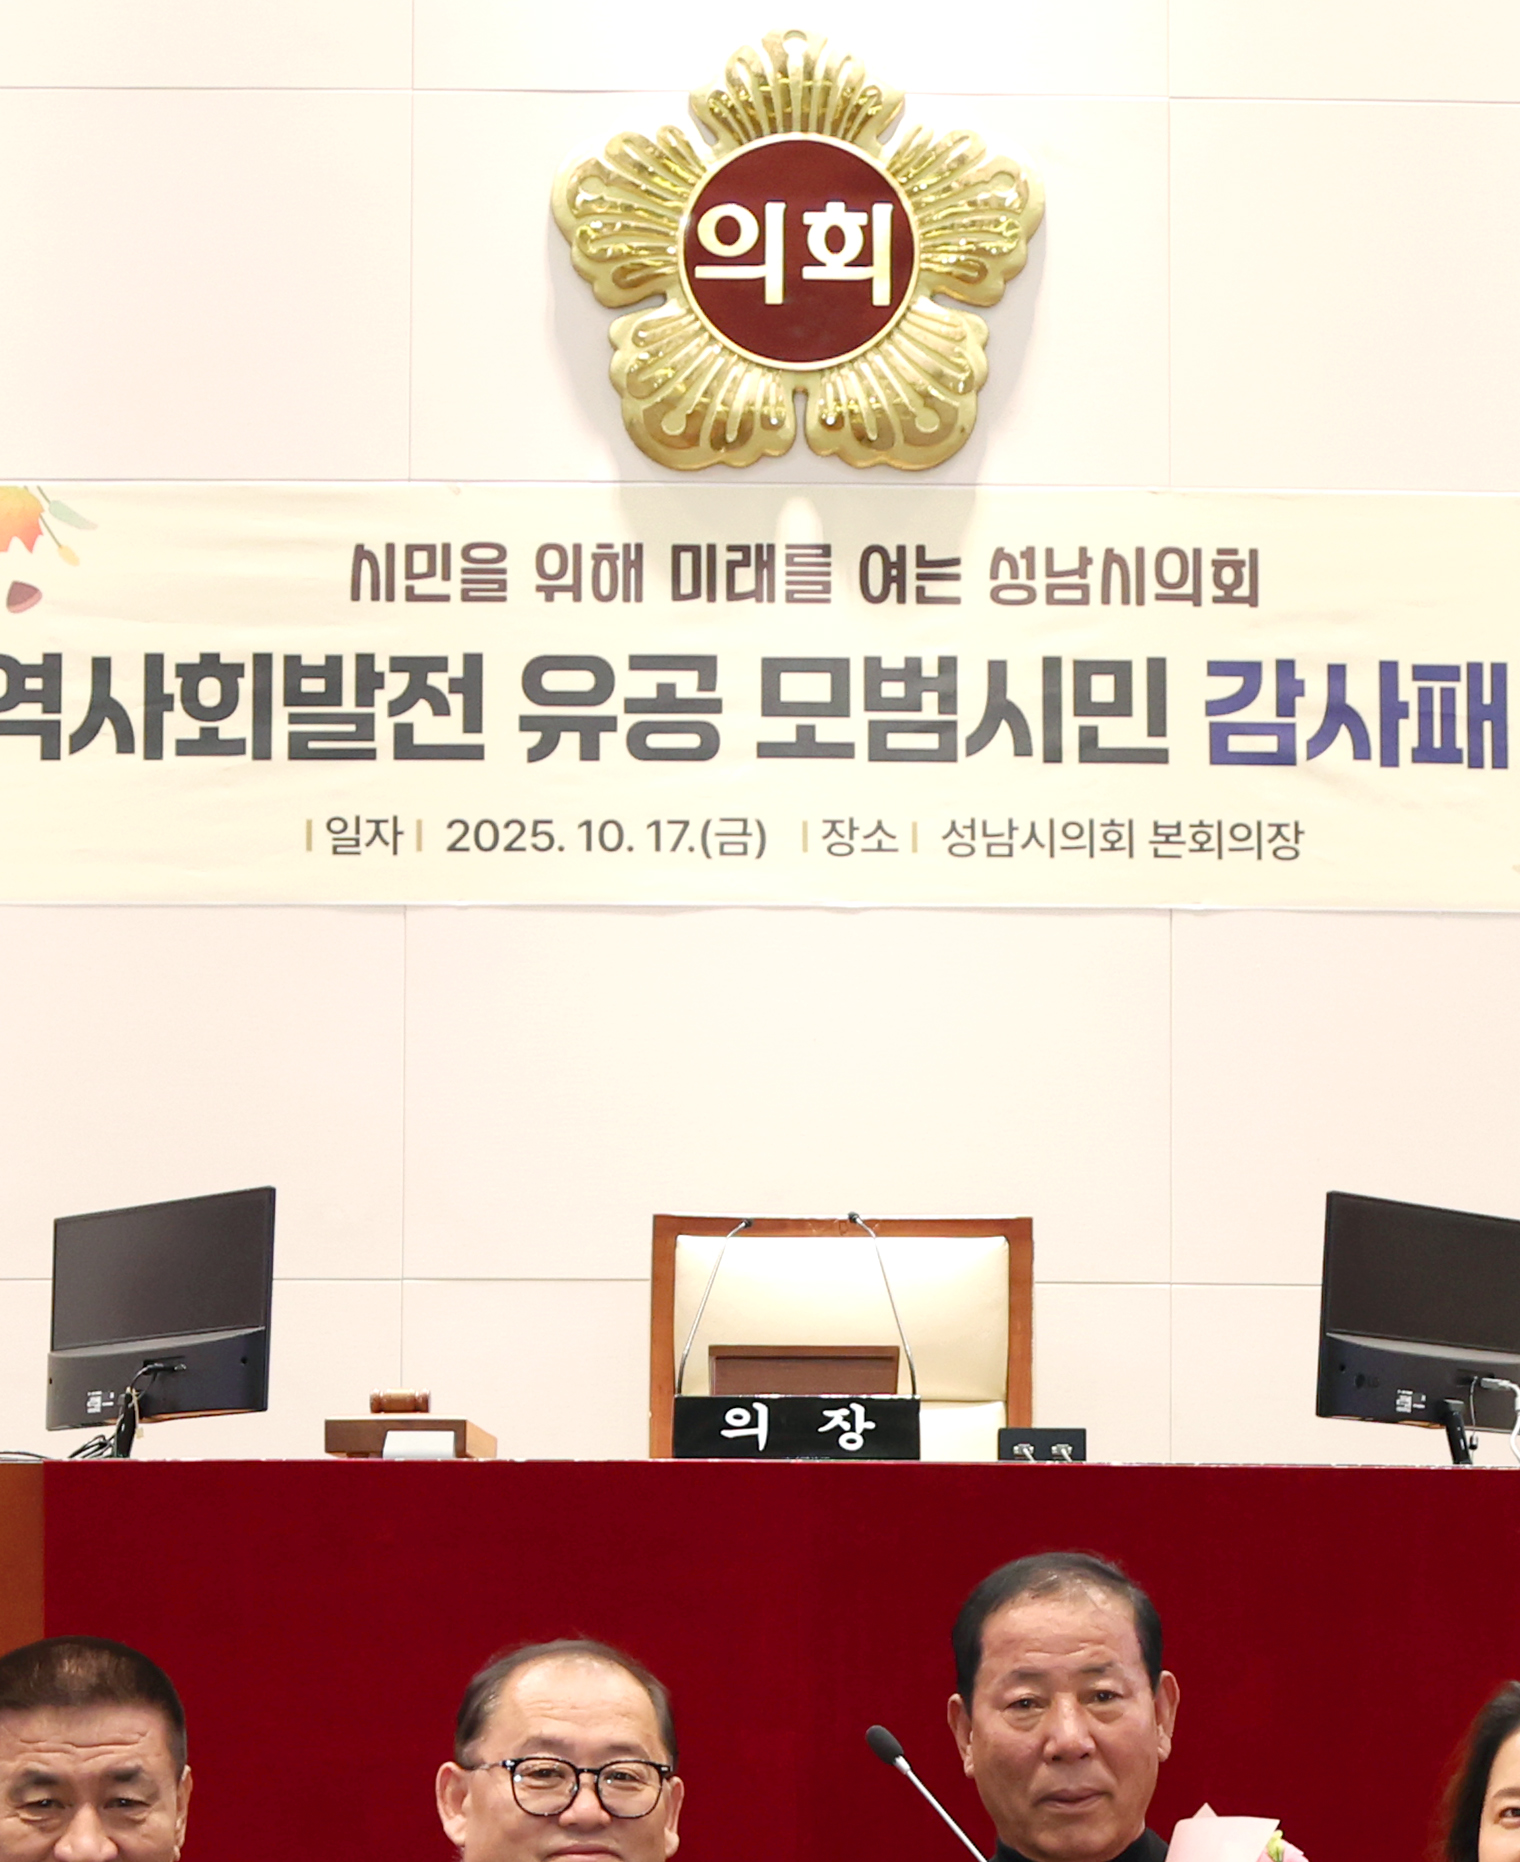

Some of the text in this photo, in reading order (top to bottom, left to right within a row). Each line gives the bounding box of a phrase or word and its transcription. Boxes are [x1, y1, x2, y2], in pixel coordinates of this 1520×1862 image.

[694, 200, 894, 306] 의회
[350, 541, 1259, 608] 시민을 위해 미래를 여는 성남시의회
[518, 654, 723, 764] 유공
[756, 655, 1170, 765] 모범시민
[1204, 658, 1509, 770] 감사패
[326, 815, 1305, 861] 일자 2025. 10. 17.(금) 장소 성남시의회 본회의장
